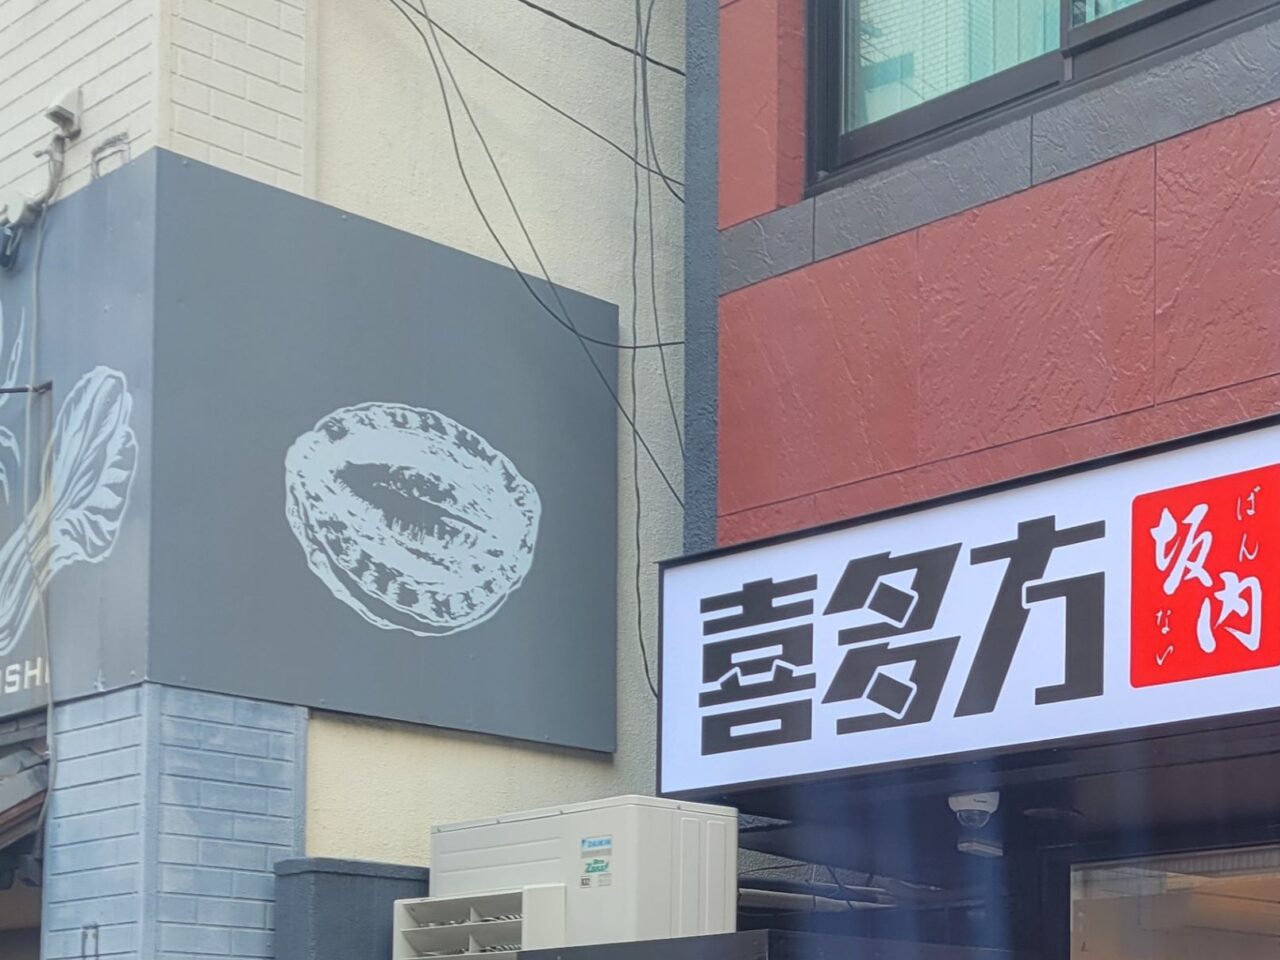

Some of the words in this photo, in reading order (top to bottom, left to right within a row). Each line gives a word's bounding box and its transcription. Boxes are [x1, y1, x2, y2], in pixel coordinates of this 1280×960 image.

[1150, 503, 1262, 655] 坂内
[1237, 485, 1263, 562] ばん
[699, 516, 1105, 755] 喜多方
